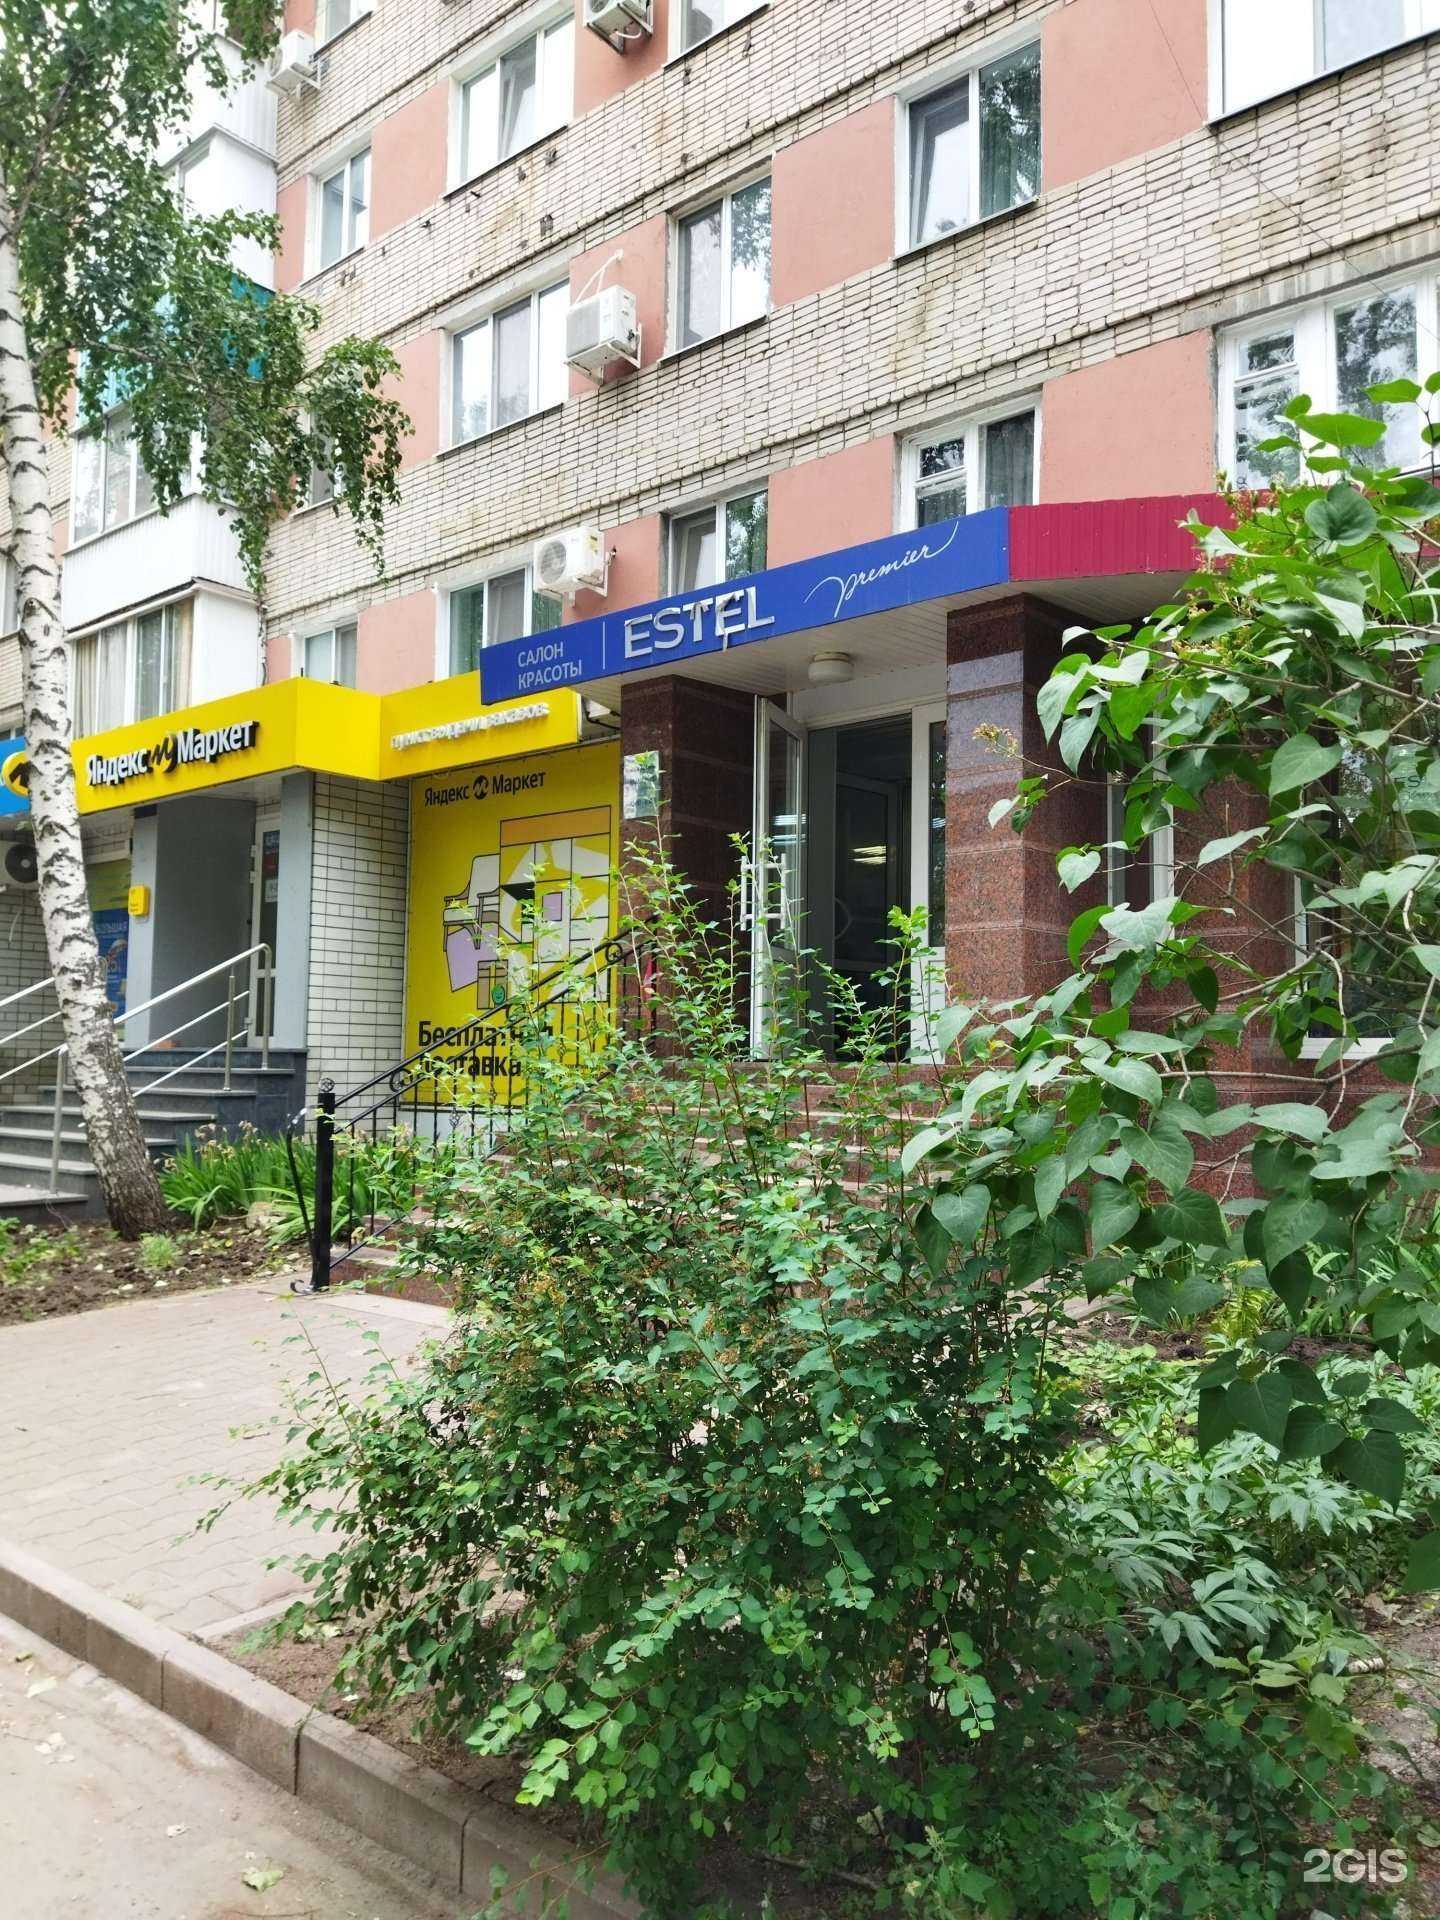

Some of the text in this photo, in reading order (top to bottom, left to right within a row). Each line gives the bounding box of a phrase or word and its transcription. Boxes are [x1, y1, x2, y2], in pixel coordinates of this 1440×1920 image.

[624, 521, 959, 659] ESTEL premier
[518, 641, 564, 668] САЛОН
[518, 659, 582, 690] КРАСОТЫ
[86, 720, 257, 786] Яндекс Маркет
[424, 771, 547, 807] Яндекс Маркет
